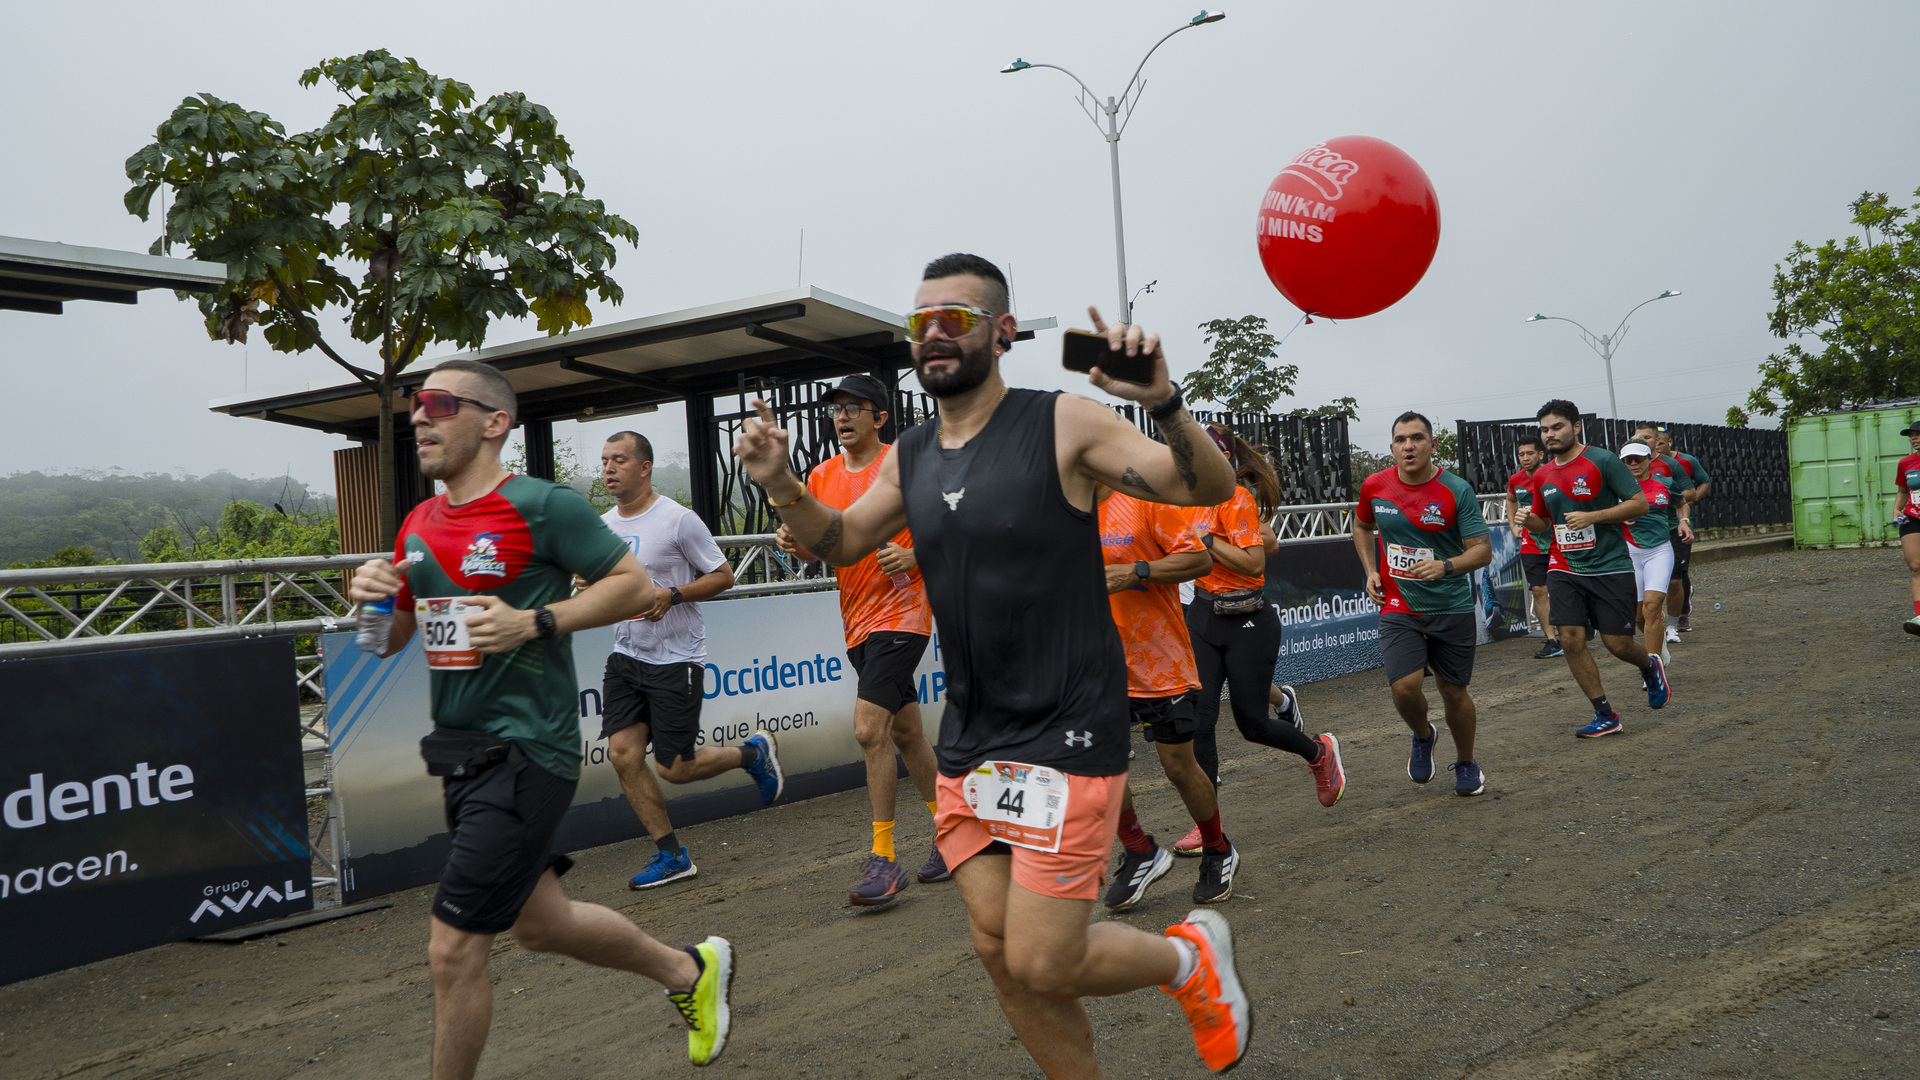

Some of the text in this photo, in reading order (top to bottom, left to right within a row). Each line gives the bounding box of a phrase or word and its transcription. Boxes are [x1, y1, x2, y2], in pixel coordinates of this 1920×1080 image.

[1268, 216, 1323, 243] MINS
[1565, 531, 1585, 543] 654
[1393, 555, 1424, 569] 150
[1314, 597, 1330, 621] de
[426, 621, 457, 646] 502
[1291, 636, 1311, 655] lado
[1312, 634, 1323, 649] de
[1325, 632, 1337, 648] los
[1339, 634, 1355, 648] que
[702, 653, 842, 700] Occidente
[712, 722, 750, 747] que
[756, 711, 819, 734] hacen.
[997, 787, 1025, 818] 44
[203, 879, 251, 897] Grupo
[189, 880, 307, 924] AVAL
